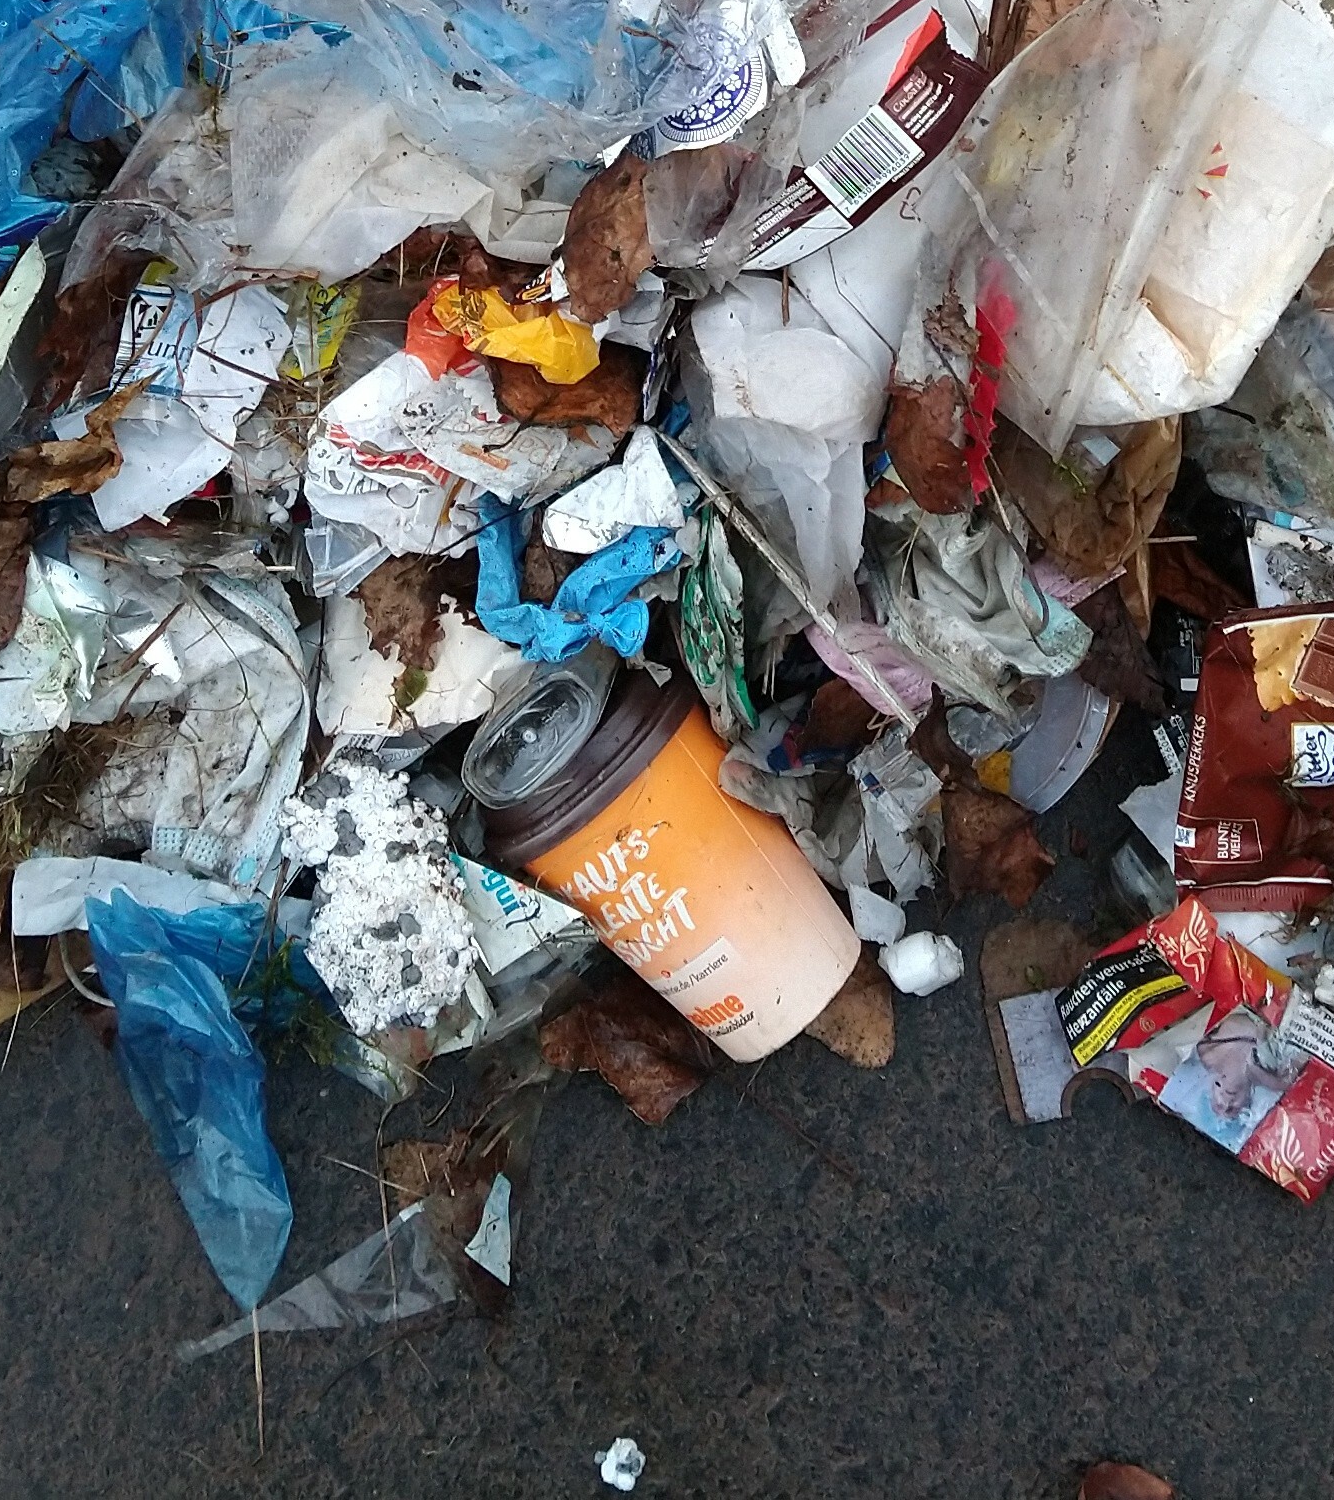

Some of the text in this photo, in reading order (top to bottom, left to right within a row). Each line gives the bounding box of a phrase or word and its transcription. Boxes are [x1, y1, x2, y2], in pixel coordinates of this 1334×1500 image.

[1183, 714, 1207, 802] KNUSPERKEKS
[1217, 820, 1232, 859] BUNTE
[1060, 977, 1098, 1021] Rauchen
[1066, 979, 1127, 1041] Herzanfälle
